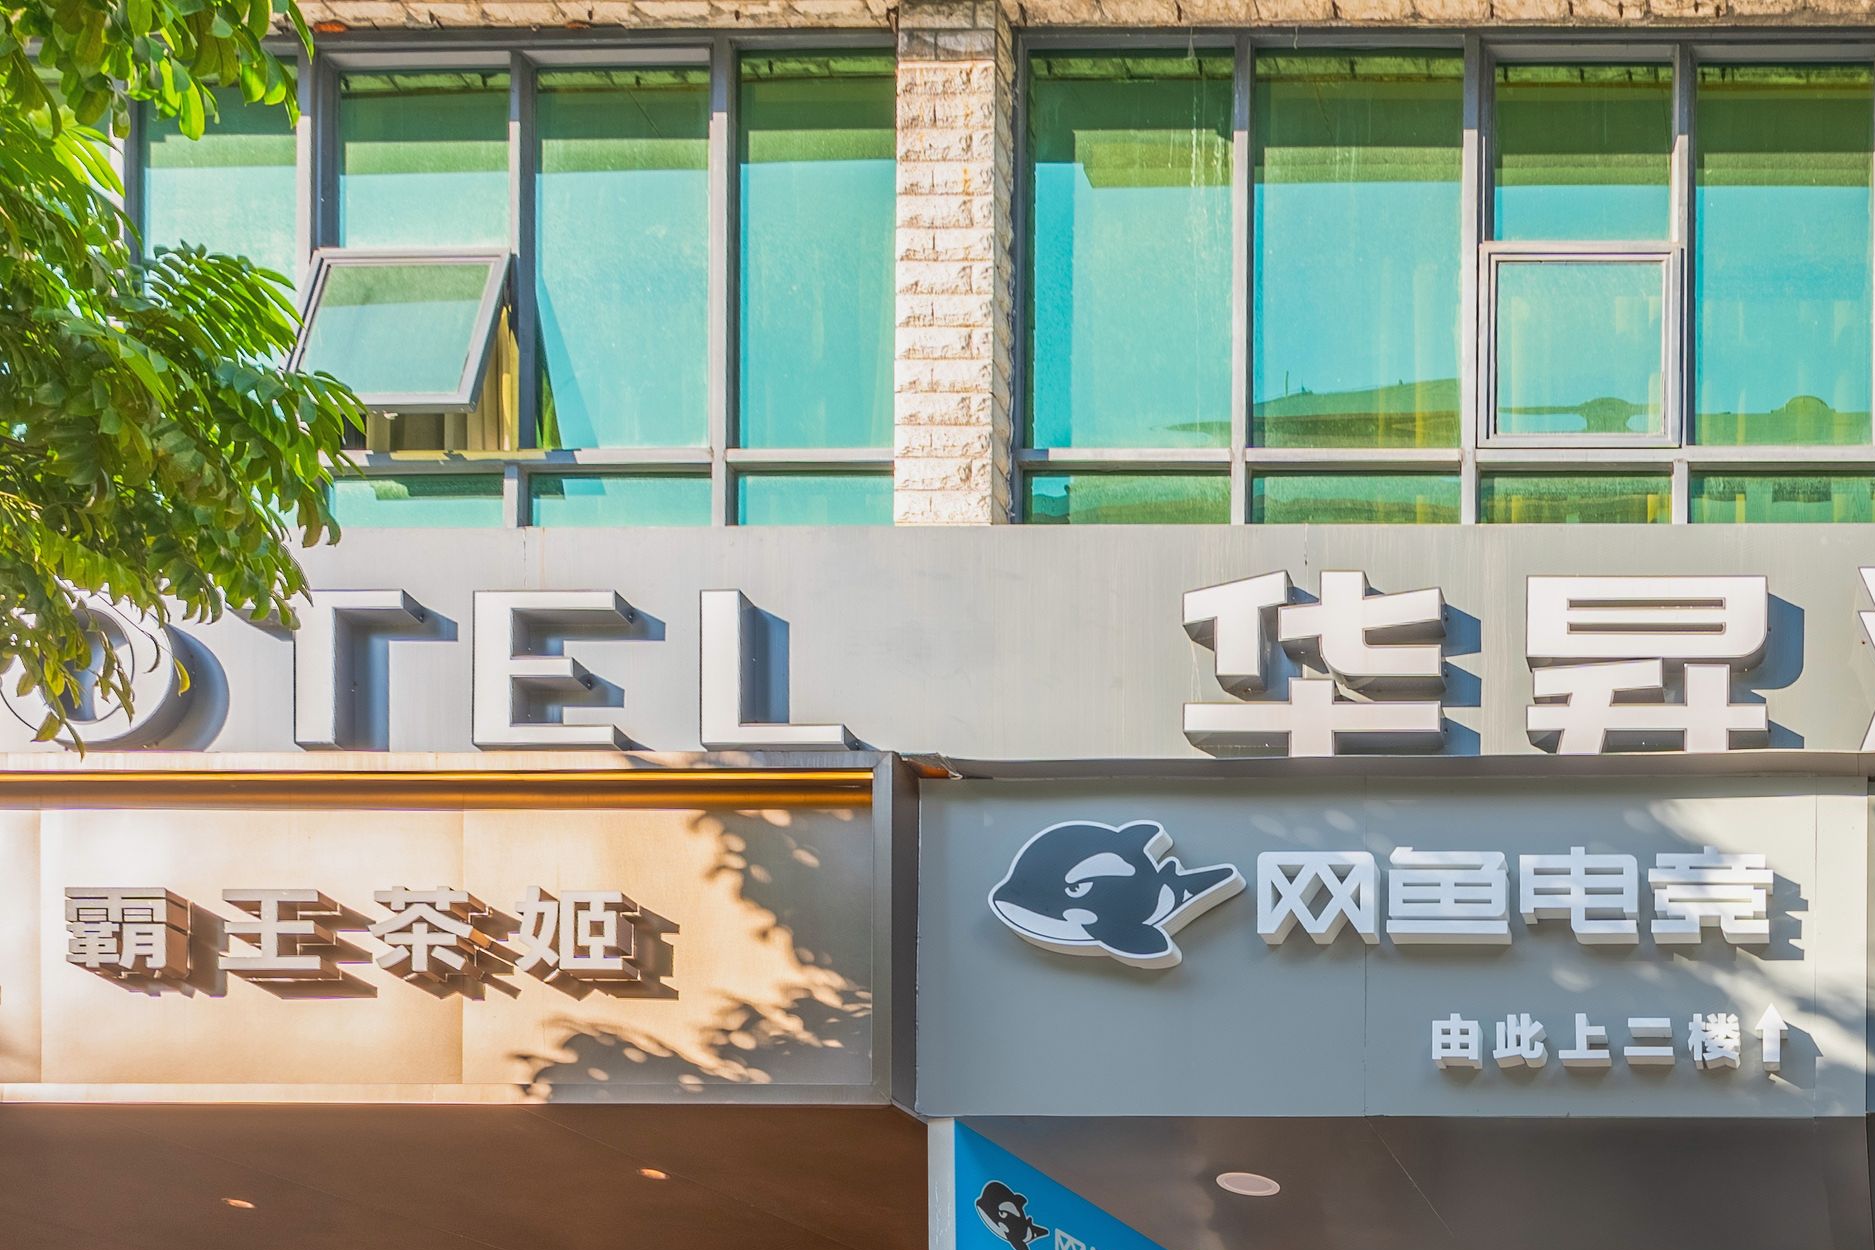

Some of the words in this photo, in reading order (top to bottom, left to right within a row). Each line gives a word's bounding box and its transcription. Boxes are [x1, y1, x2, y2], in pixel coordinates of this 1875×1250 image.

[64, 885, 634, 980] 霸王茶姬
[1257, 846, 1774, 945] 网鱼电竞
[1430, 1012, 1742, 1070] 由此上二楼
